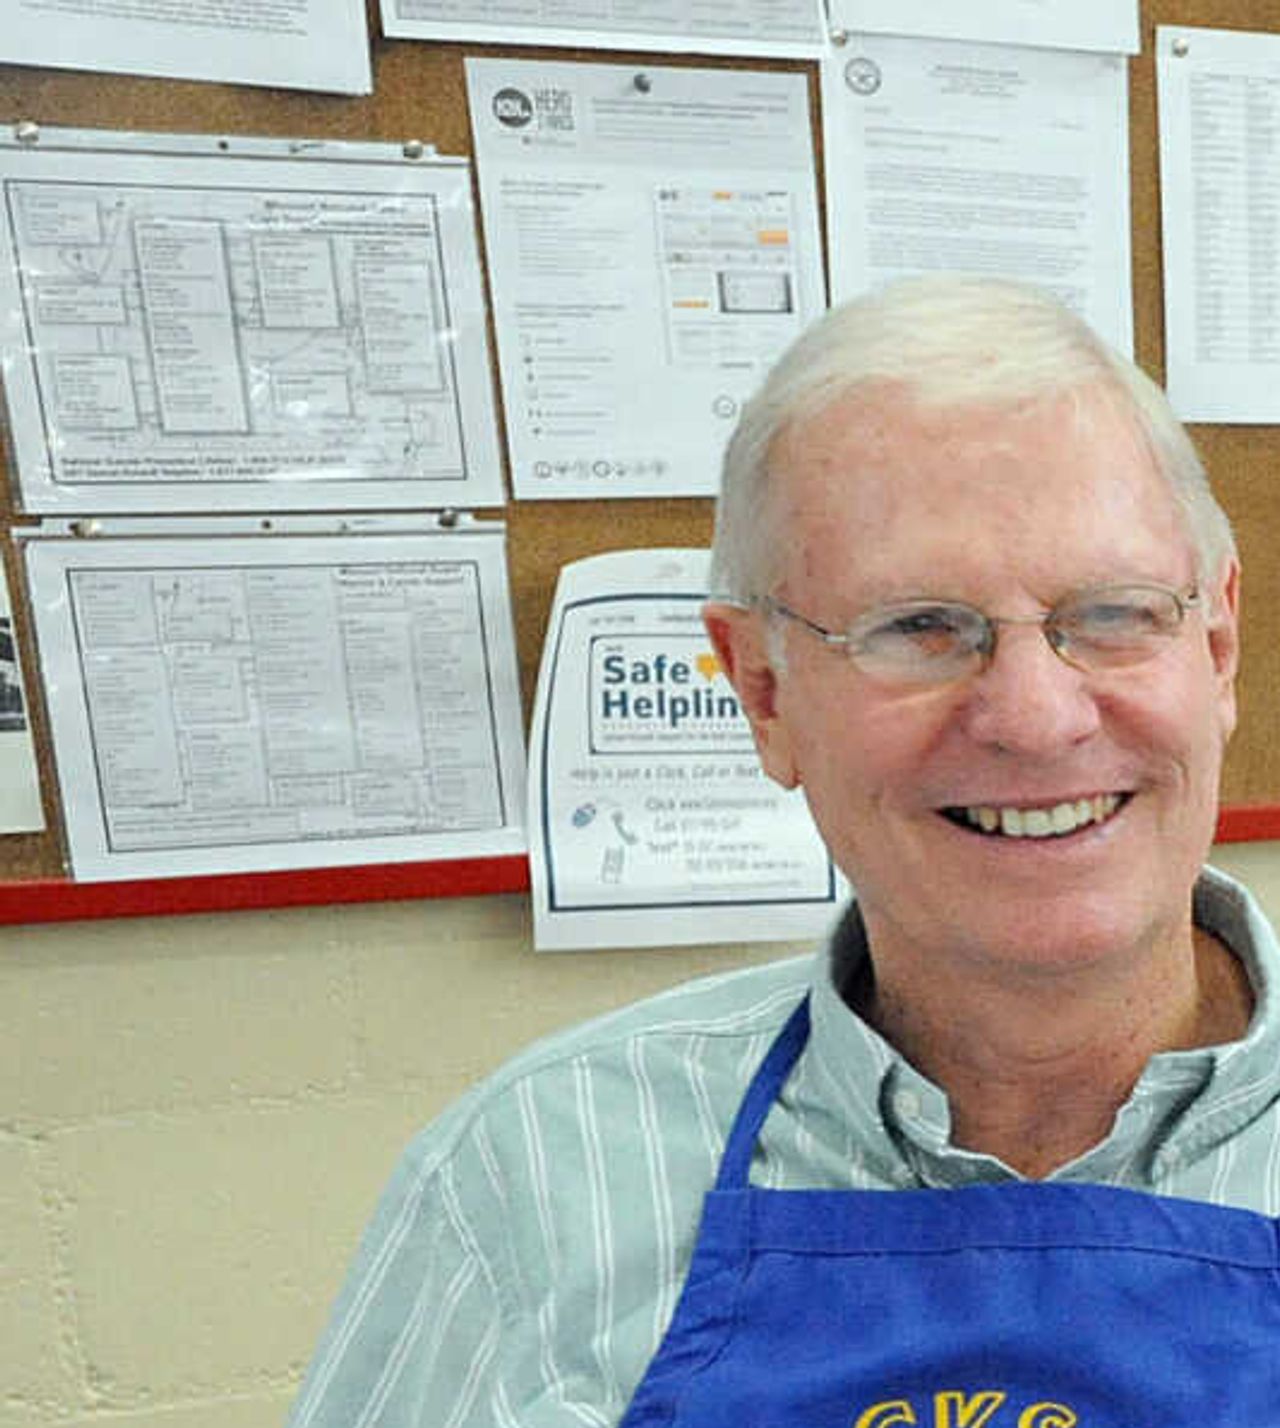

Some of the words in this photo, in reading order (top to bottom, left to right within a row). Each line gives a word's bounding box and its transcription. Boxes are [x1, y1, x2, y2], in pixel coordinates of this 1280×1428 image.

[604, 654, 690, 684] Safe
[602, 688, 739, 727] Helplin
[692, 766, 713, 778] Call
